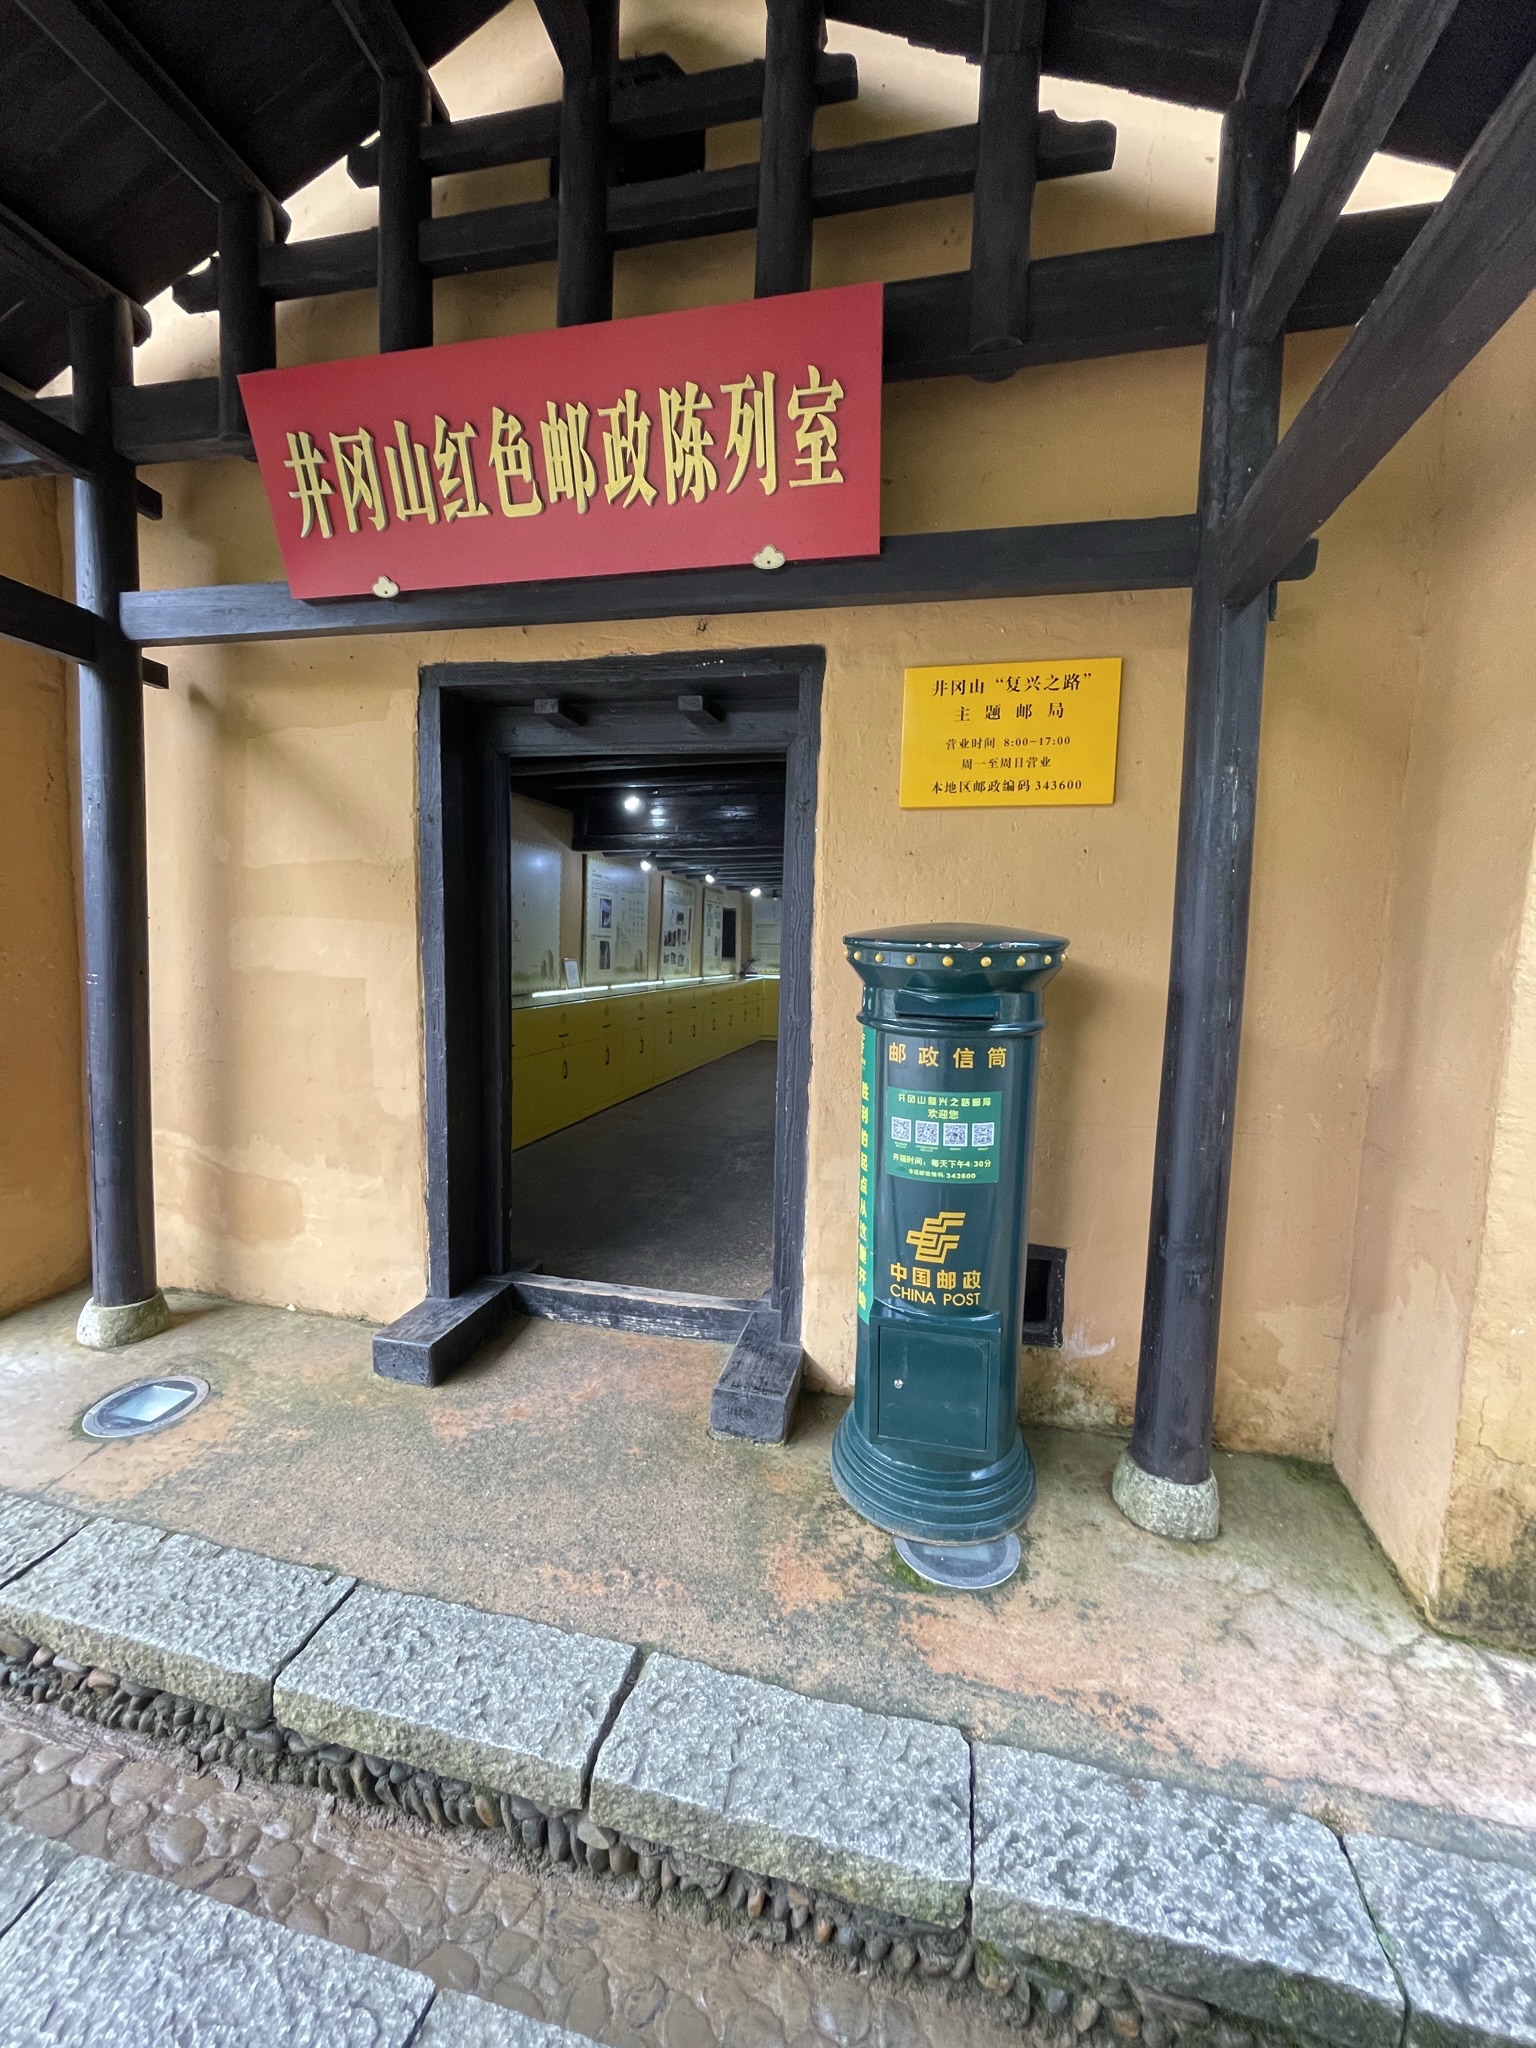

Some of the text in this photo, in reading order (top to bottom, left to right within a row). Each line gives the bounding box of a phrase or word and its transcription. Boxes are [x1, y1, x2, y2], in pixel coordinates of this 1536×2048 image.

[284, 364, 845, 539] 井冈山红色邮政陈列室
[954, 702, 1064, 723] 主题邮局
[945, 736, 996, 751] 营业时间
[961, 755, 1052, 771] 周一至周日营业
[888, 1041, 1007, 1069] 邮政信筒
[927, 1108, 959, 1120] 欢迎您
[890, 1262, 981, 1290] 中国邮政
[890, 1283, 981, 1306] CHINA POST
